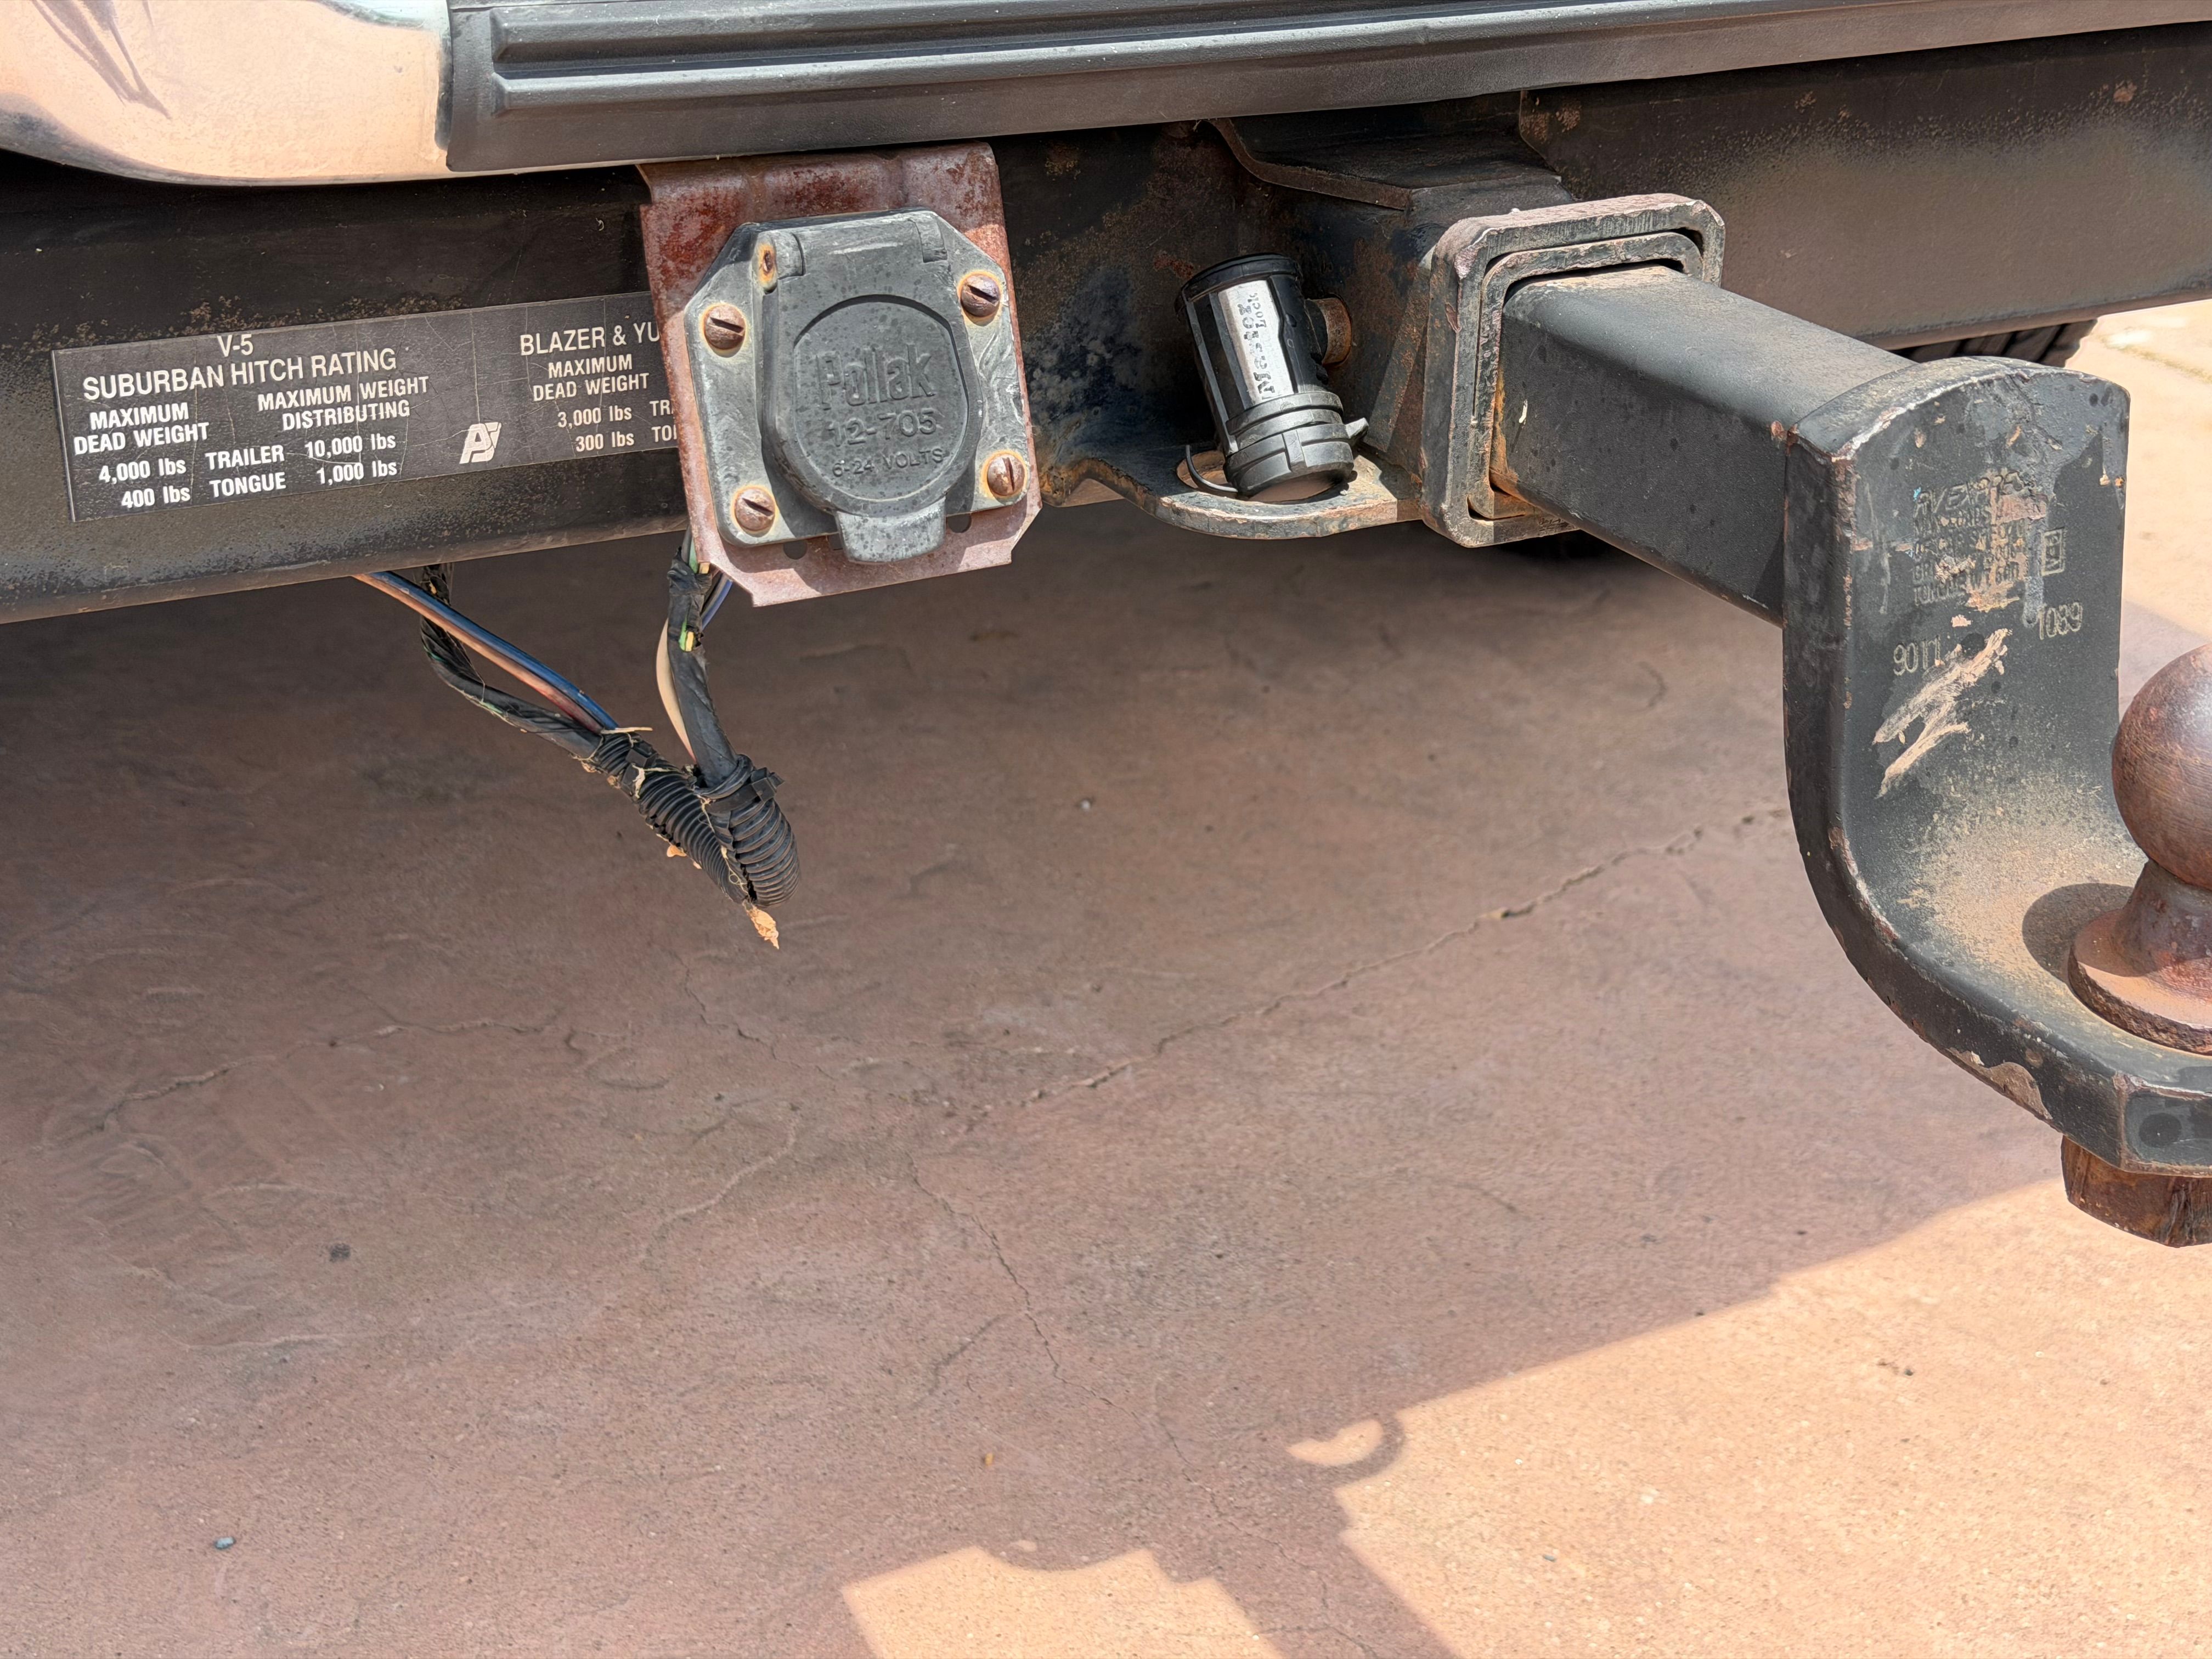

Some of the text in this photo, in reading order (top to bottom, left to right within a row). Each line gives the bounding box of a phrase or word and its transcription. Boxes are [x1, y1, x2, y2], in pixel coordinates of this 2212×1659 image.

[1247, 292, 1267, 329] Lock
[217, 334, 254, 357] V-5
[521, 327, 605, 356] BLAZER
[613, 325, 627, 346] &
[1237, 303, 1276, 394] Master
[83, 348, 397, 400] SUBURBAN HITCH RATING
[548, 354, 633, 379] MAXIMUM
[815, 343, 935, 410] Pollak
[257, 376, 430, 411] MAXIMUM WEIGHT
[533, 373, 649, 401] DEAD WEIGHT
[90, 403, 189, 430] MAXIMUM
[282, 399, 410, 431] DISTRIBUTING
[557, 399, 675, 429] 3,000 lbs TR
[826, 407, 936, 447] 12-705
[75, 422, 210, 455] DEAD WEIGHT
[575, 433, 604, 452] 300
[611, 431, 634, 447] lbs
[99, 433, 396, 484] 4,000 lbs TRAILER 10,000 lbs
[832, 448, 945, 477] 6-24 VOLTS
[121, 461, 397, 508] 400 lbs TONGUE 1,000 lbs
